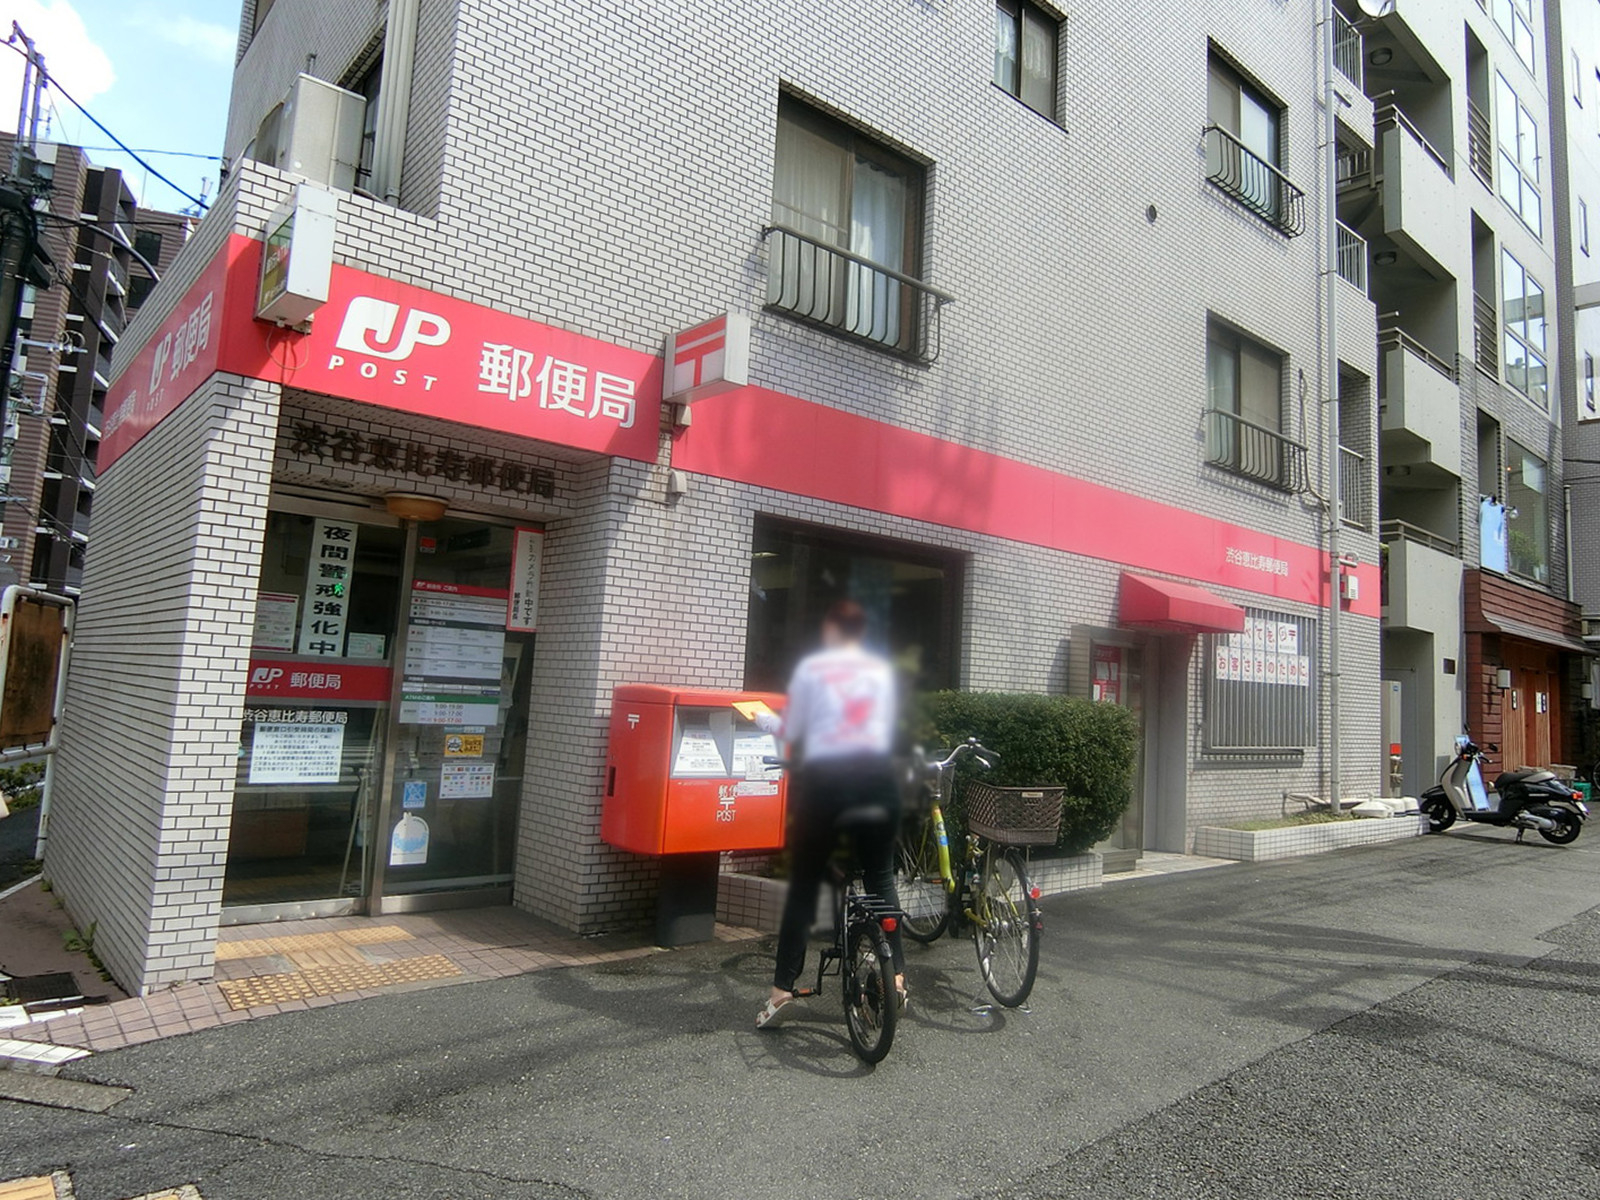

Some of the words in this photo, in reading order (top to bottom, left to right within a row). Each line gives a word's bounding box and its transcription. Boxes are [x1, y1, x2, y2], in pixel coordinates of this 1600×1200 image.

[328, 355, 438, 391] POST
[335, 296, 451, 361] JP
[477, 341, 636, 429] 郵便局
[309, 525, 352, 655] 夜間警戒強化中
[252, 667, 283, 683] JP
[290, 672, 341, 690] 郵便局
[716, 810, 736, 821] POST
